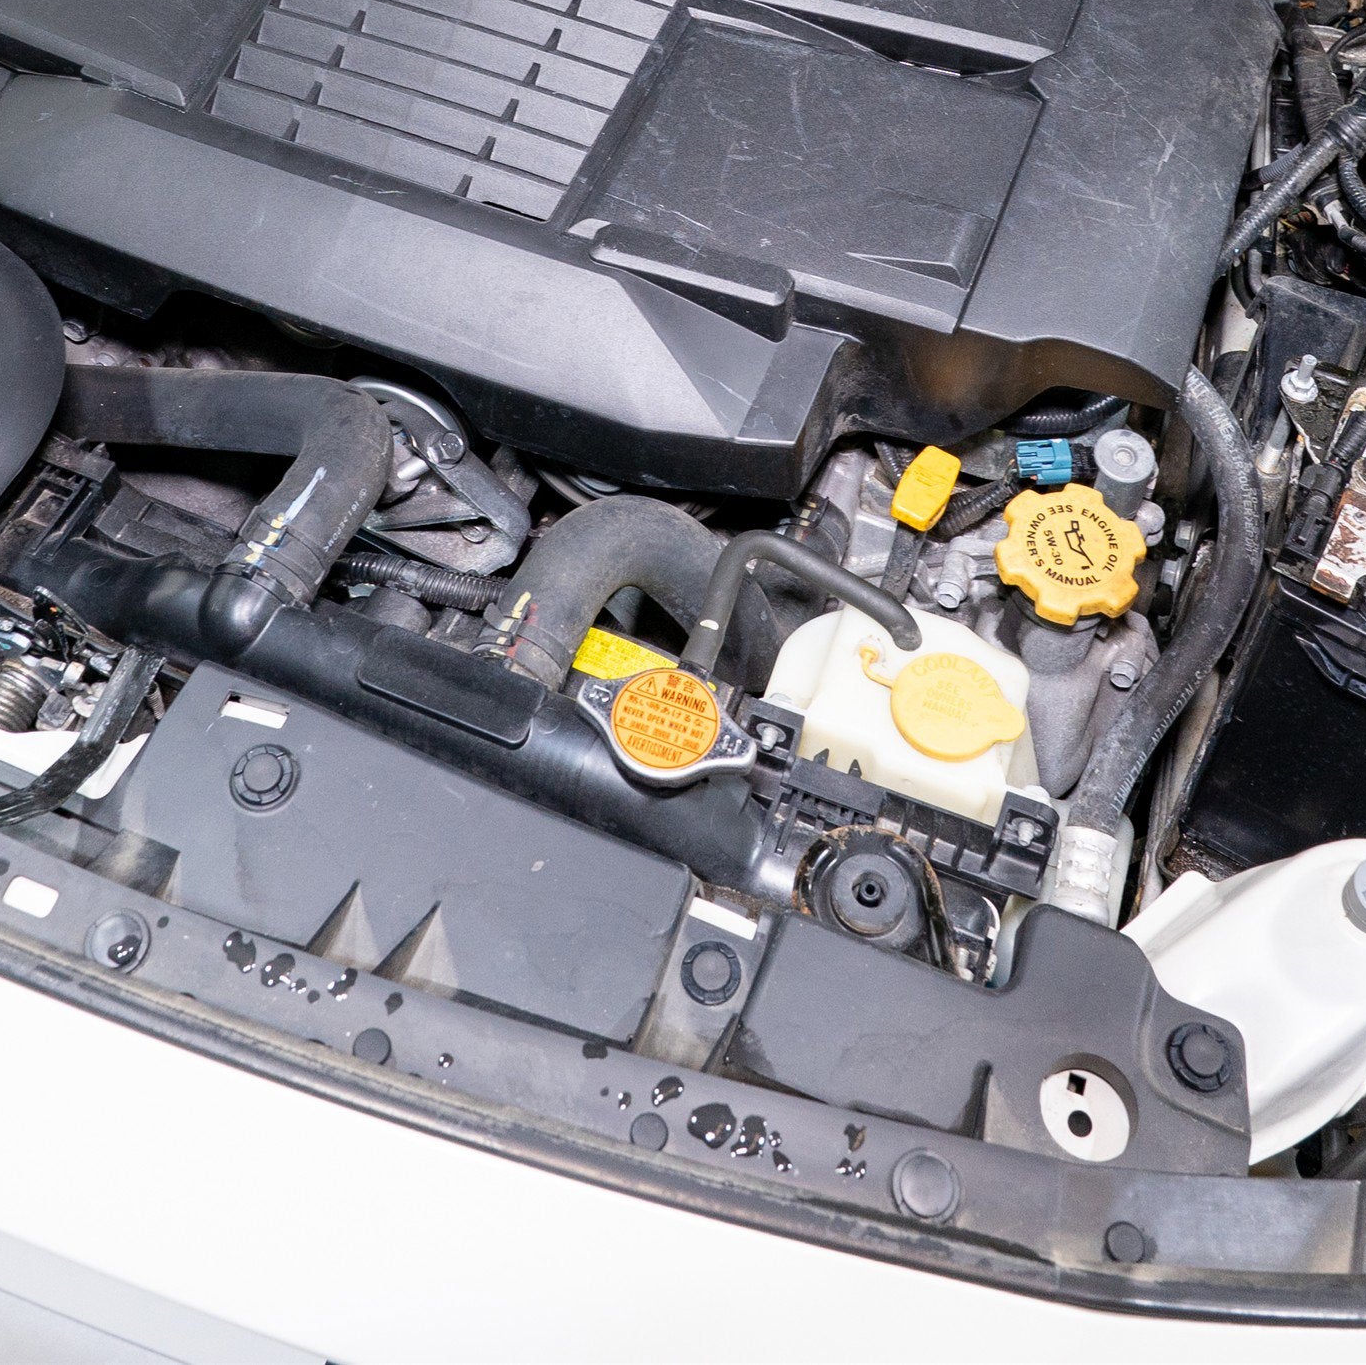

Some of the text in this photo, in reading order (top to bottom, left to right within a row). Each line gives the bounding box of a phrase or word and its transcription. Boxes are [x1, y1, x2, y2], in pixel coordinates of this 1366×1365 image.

[1026, 504, 1102, 587] SEE OWNER'S MANUAL
[1043, 529, 1063, 566] 5W-30
[1081, 508, 1119, 572] ENGINE OIL
[665, 673, 699, 695] 警告
[911, 654, 999, 700] COOLANT
[936, 680, 962, 696] SEE
[660, 687, 708, 713] WARNING
[622, 705, 645, 720] NEVER
[646, 712, 666, 725] OPEN
[667, 719, 688, 734] WHEN
